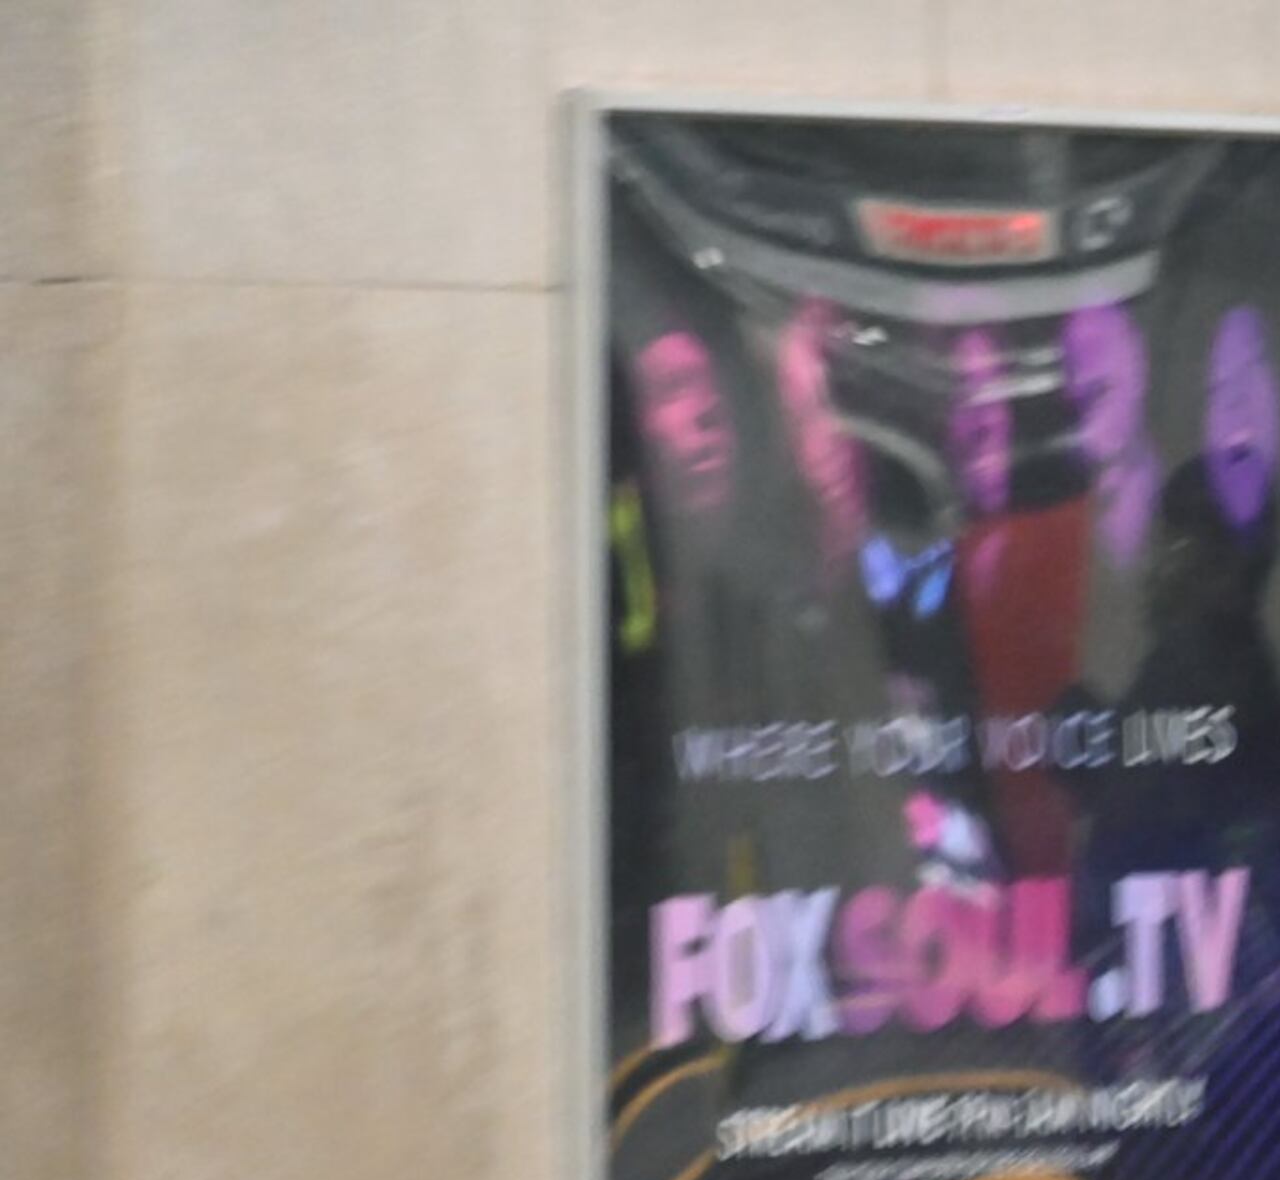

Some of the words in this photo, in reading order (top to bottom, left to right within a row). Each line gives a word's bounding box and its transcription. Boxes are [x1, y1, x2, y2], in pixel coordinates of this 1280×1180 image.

[673, 719, 837, 781] WHERE
[843, 711, 971, 778] YOUR
[978, 709, 1116, 773] VOICE
[1122, 704, 1238, 767] LIVES
[717, 1103, 844, 1161] STREAM
